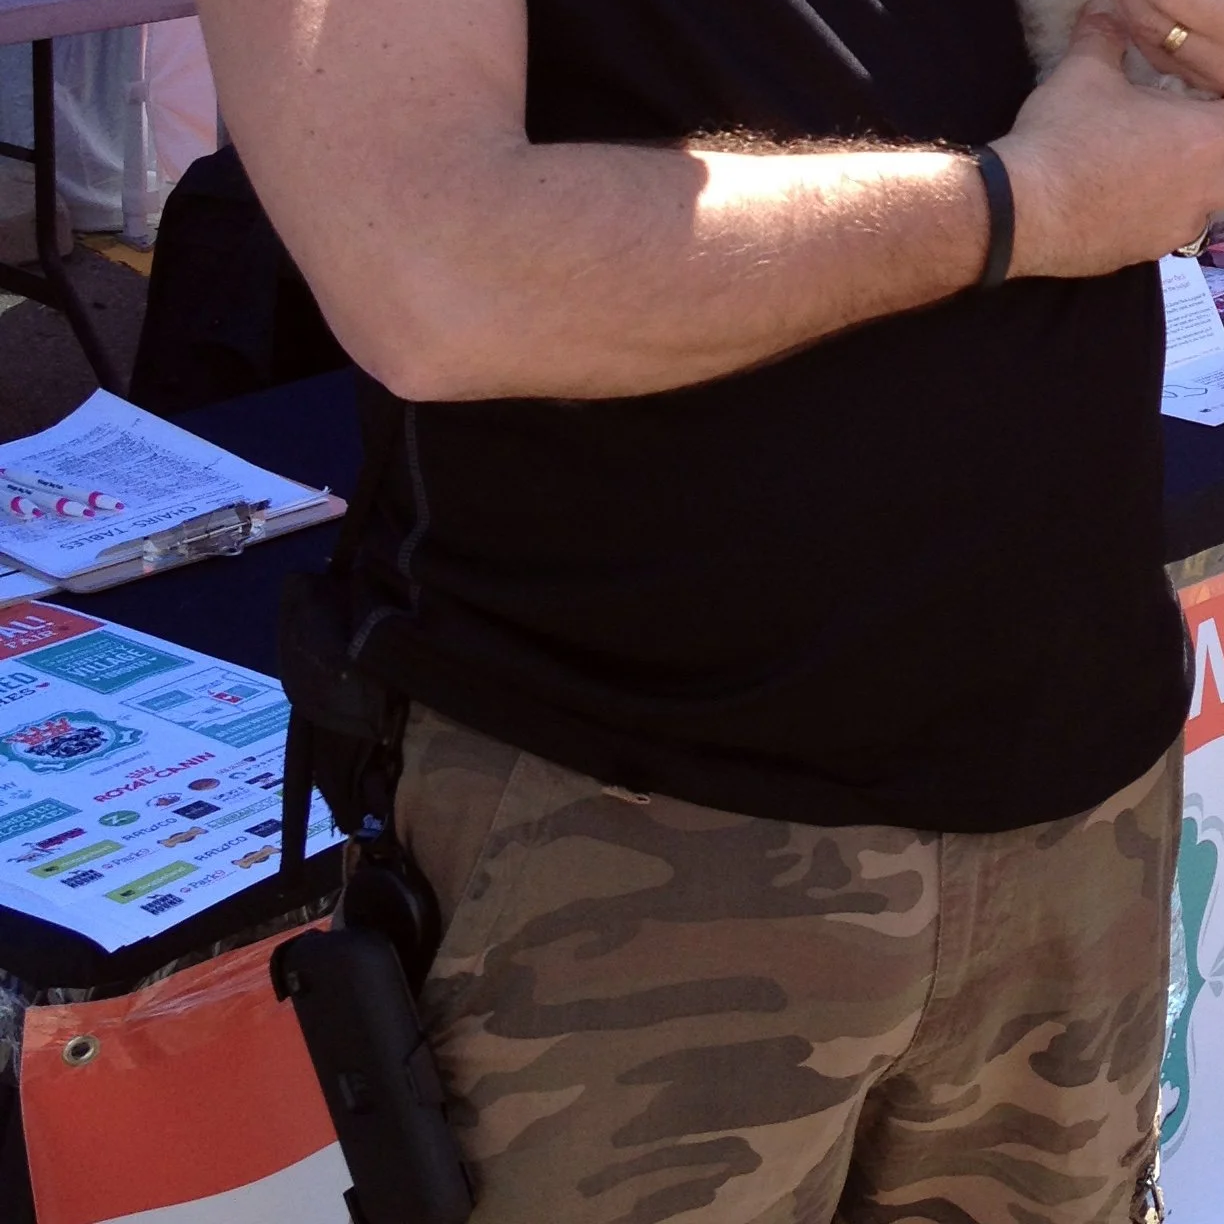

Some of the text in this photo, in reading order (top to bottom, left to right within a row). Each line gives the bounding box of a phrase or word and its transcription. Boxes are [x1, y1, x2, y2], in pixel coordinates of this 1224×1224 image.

[68, 648, 148, 677] VILLAGE
[94, 777, 157, 803] ROYAL
[154, 751, 216, 779] CANIN
